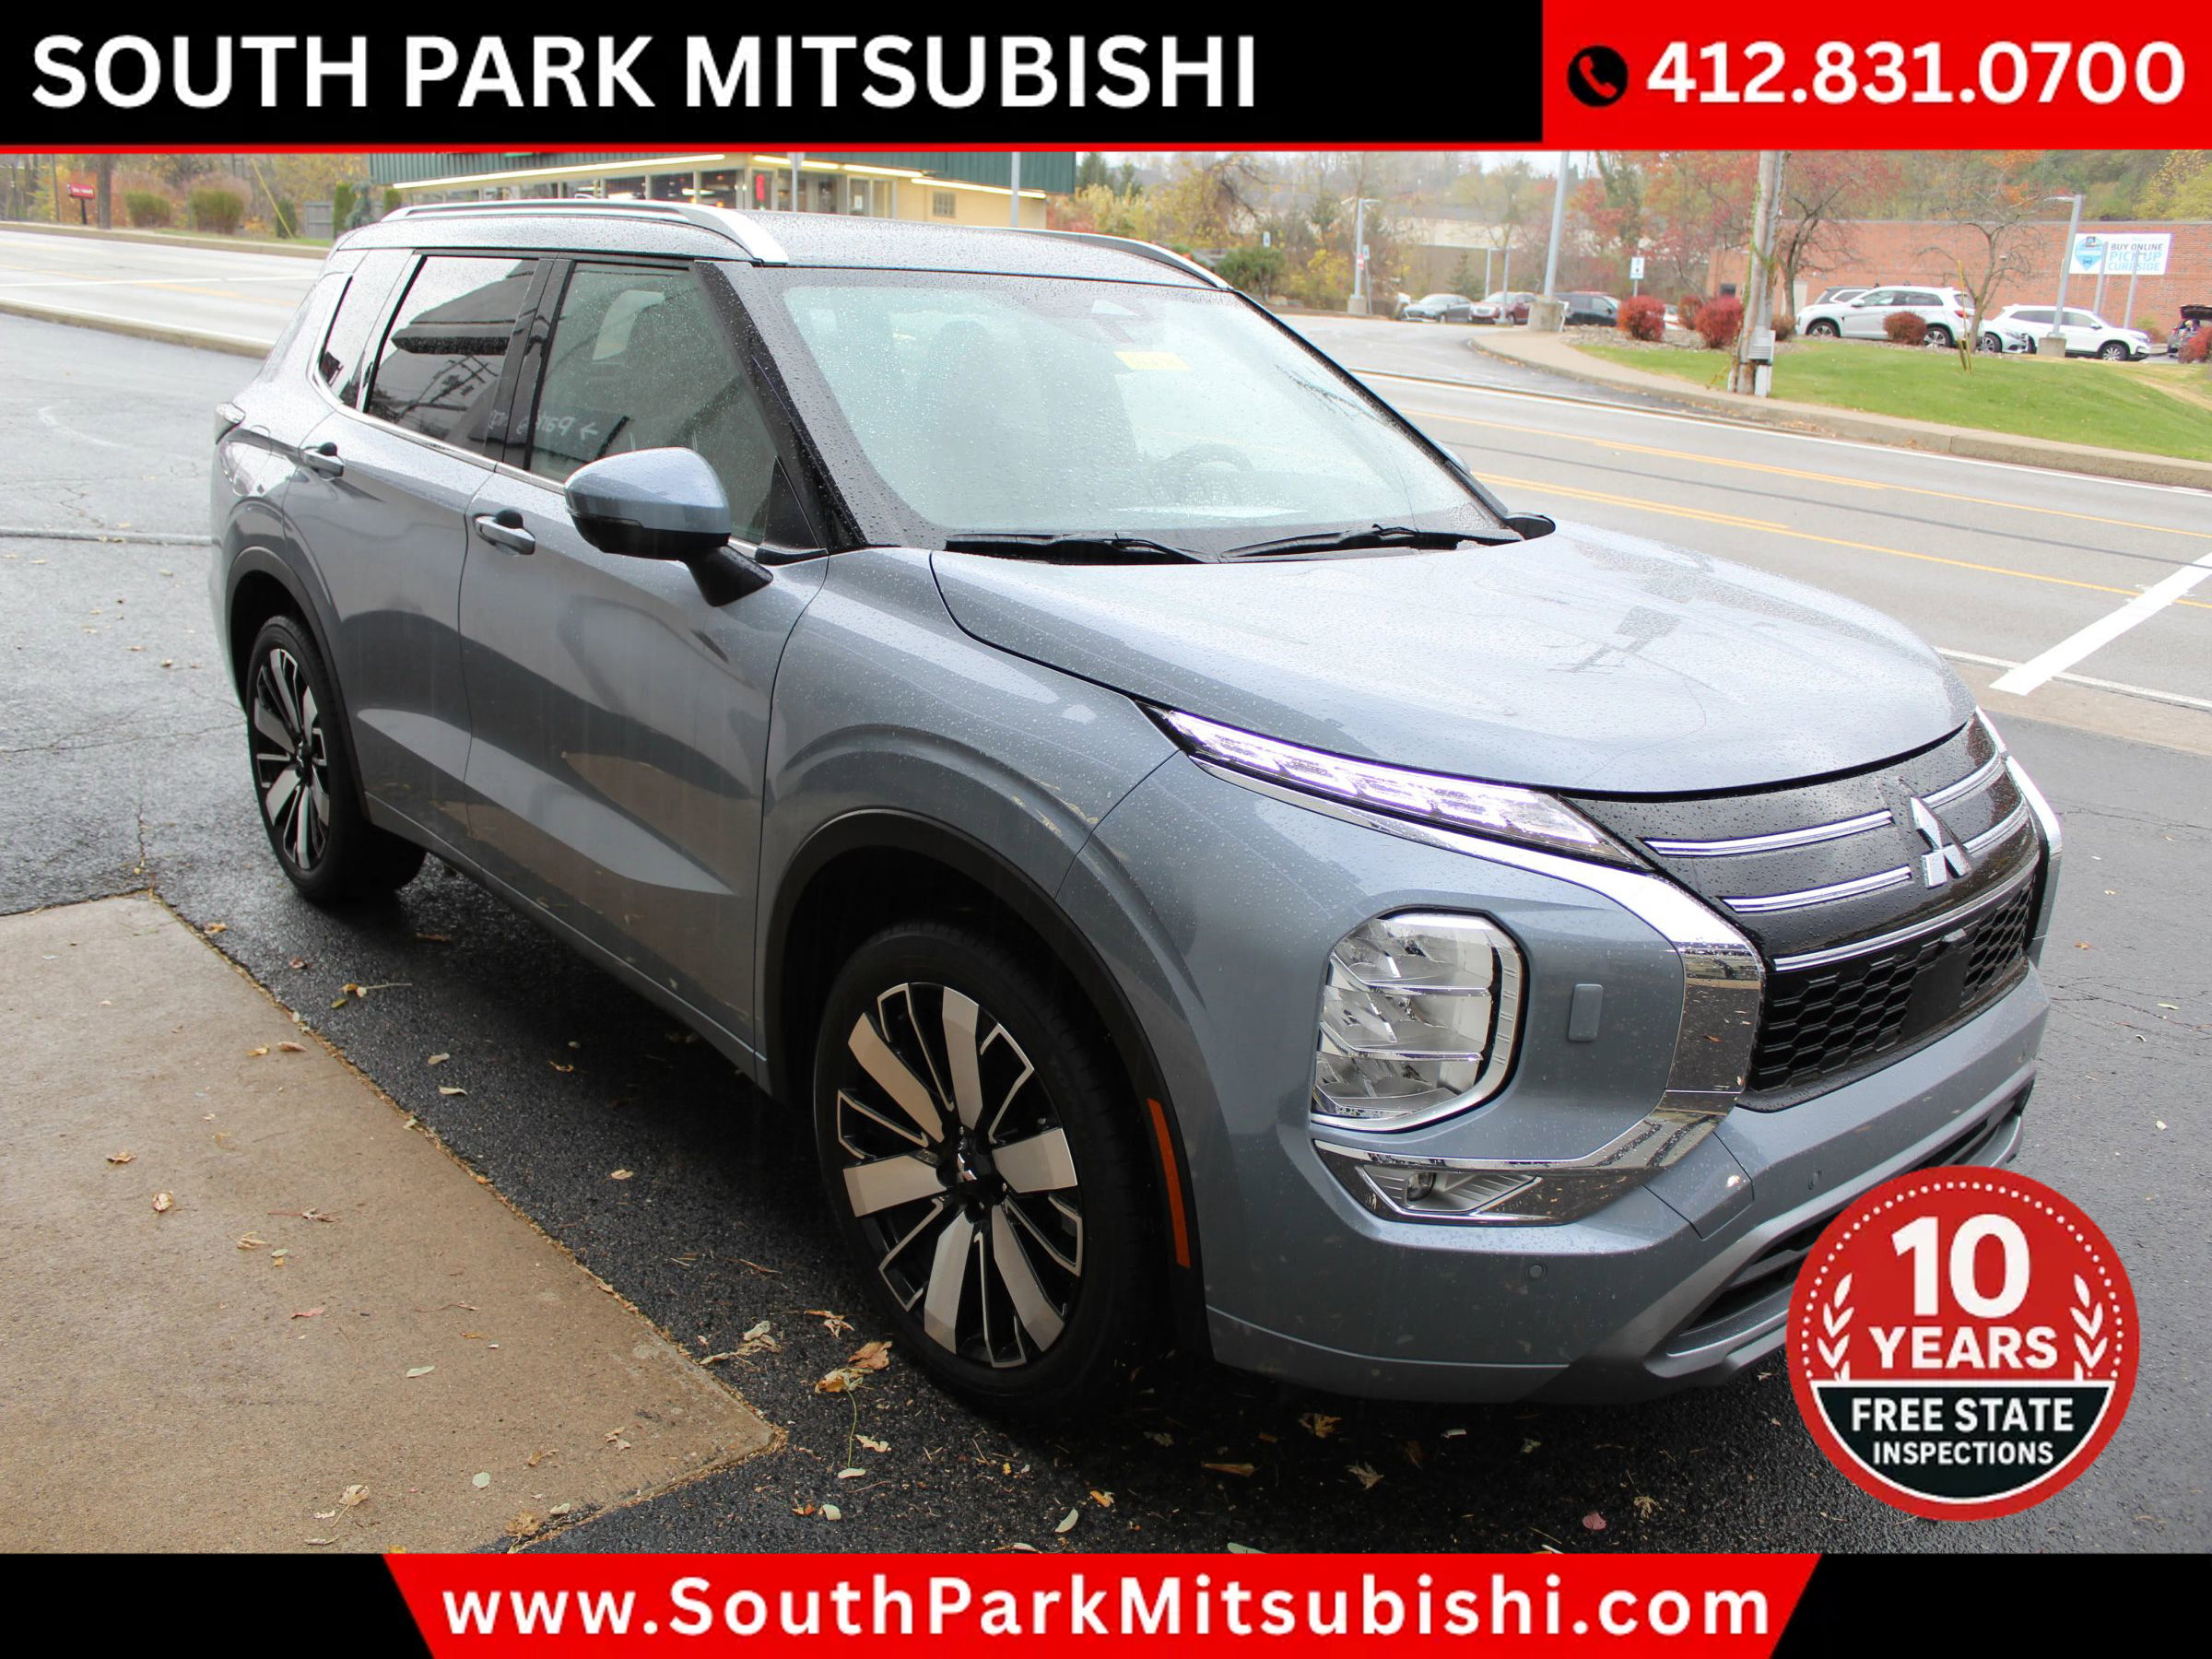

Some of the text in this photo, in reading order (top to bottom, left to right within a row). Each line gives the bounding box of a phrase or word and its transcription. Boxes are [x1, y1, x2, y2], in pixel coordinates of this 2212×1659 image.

[2111, 242, 2163, 251] BUY ONLINE
[2108, 262, 2161, 271] CURSIDE
